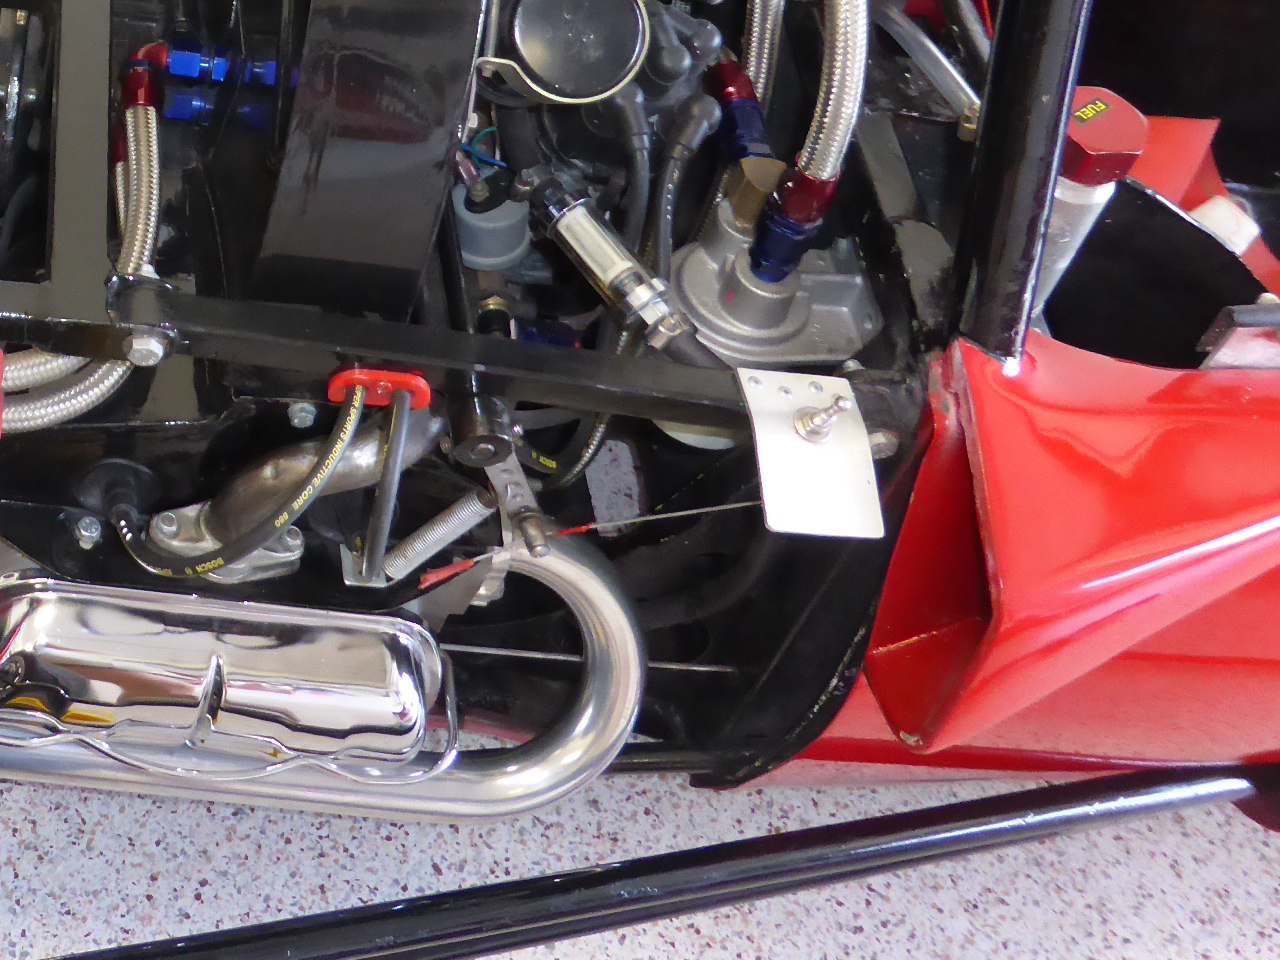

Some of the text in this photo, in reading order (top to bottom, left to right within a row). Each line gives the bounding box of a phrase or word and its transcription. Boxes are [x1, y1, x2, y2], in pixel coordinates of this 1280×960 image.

[1074, 100, 1107, 120] FUEL
[340, 408, 357, 440] SPORTS
[313, 438, 345, 487] INDUCTIVE
[291, 485, 314, 511] CORE
[195, 557, 225, 573] BOSCH
